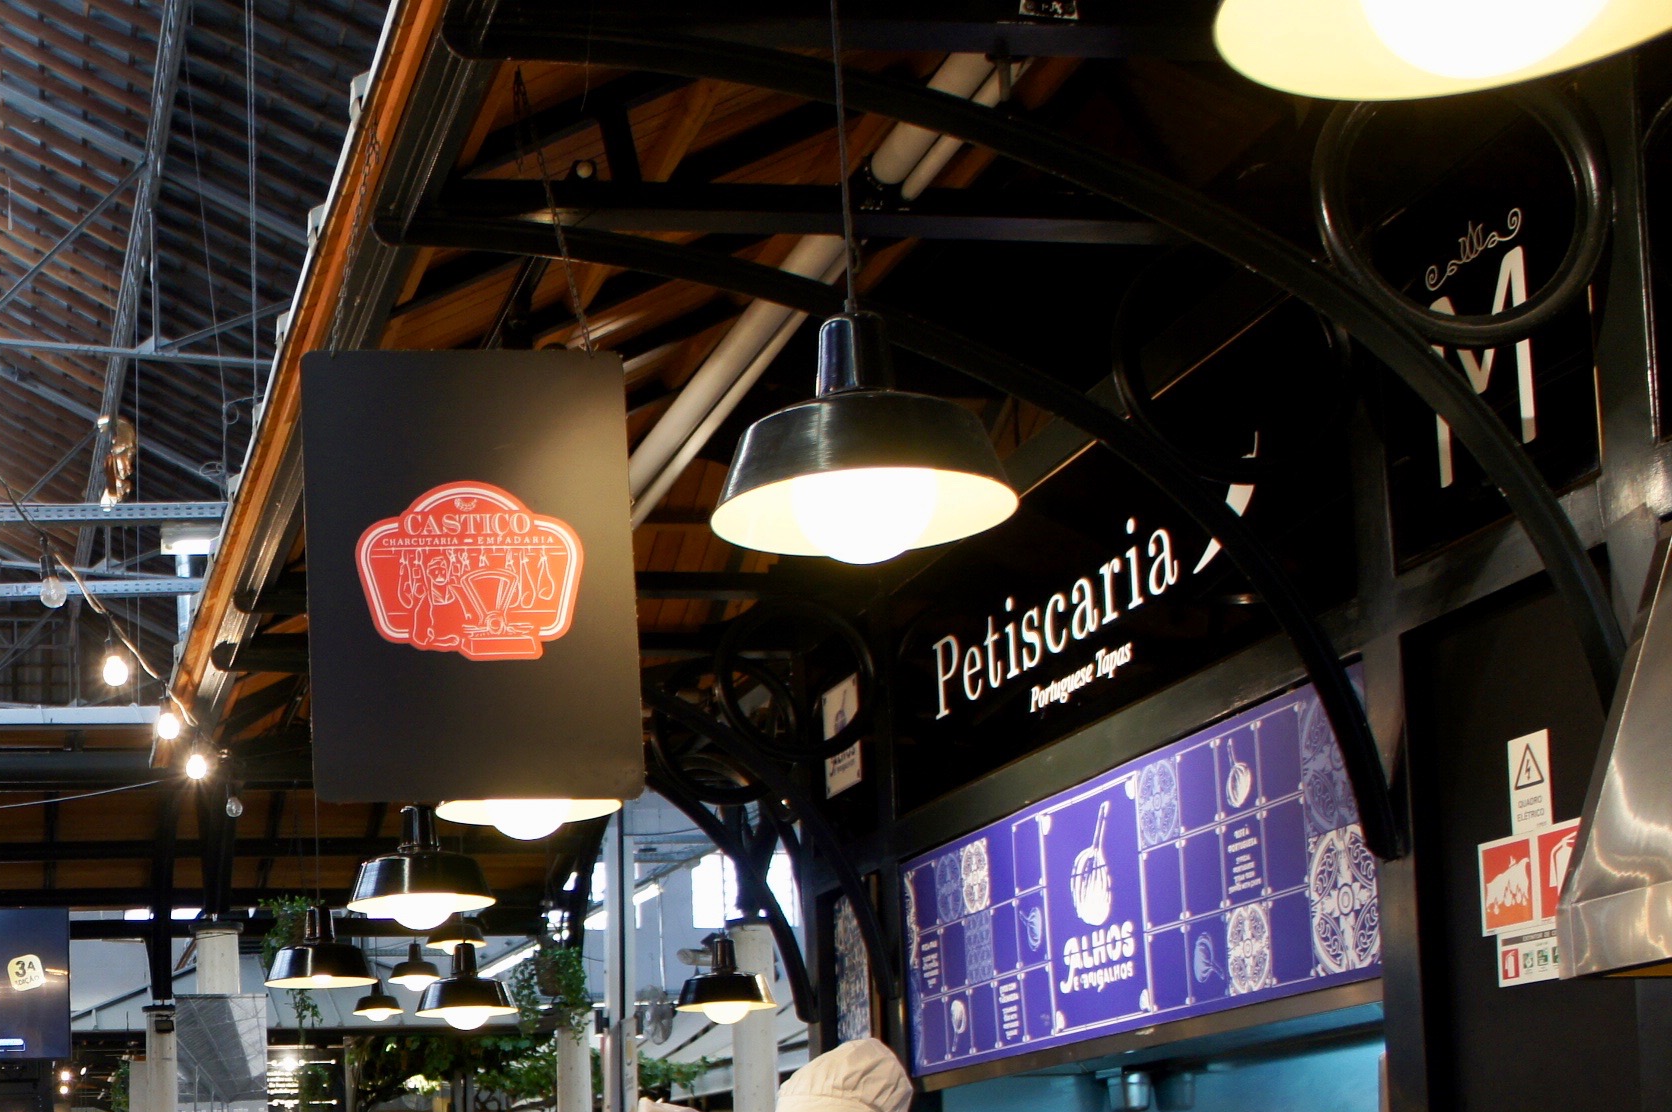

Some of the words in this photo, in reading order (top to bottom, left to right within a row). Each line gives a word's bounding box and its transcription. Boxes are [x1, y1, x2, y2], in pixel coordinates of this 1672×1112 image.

[404, 512, 531, 539] CASTIÇO
[382, 536, 458, 546] CHARCUTARIA
[477, 535, 554, 545] EMPADARIA
[932, 516, 1178, 720] Petiscaria
[1029, 662, 1094, 713] Portuguese
[1095, 642, 1132, 680] Tapas
[1516, 808, 1545, 823] ELÉTRICO
[1517, 795, 1543, 809] QUADRO
[1060, 920, 1135, 994] ALHOS
[1073, 976, 1080, 991] E
[1080, 961, 1134, 992] BUGALHOS
